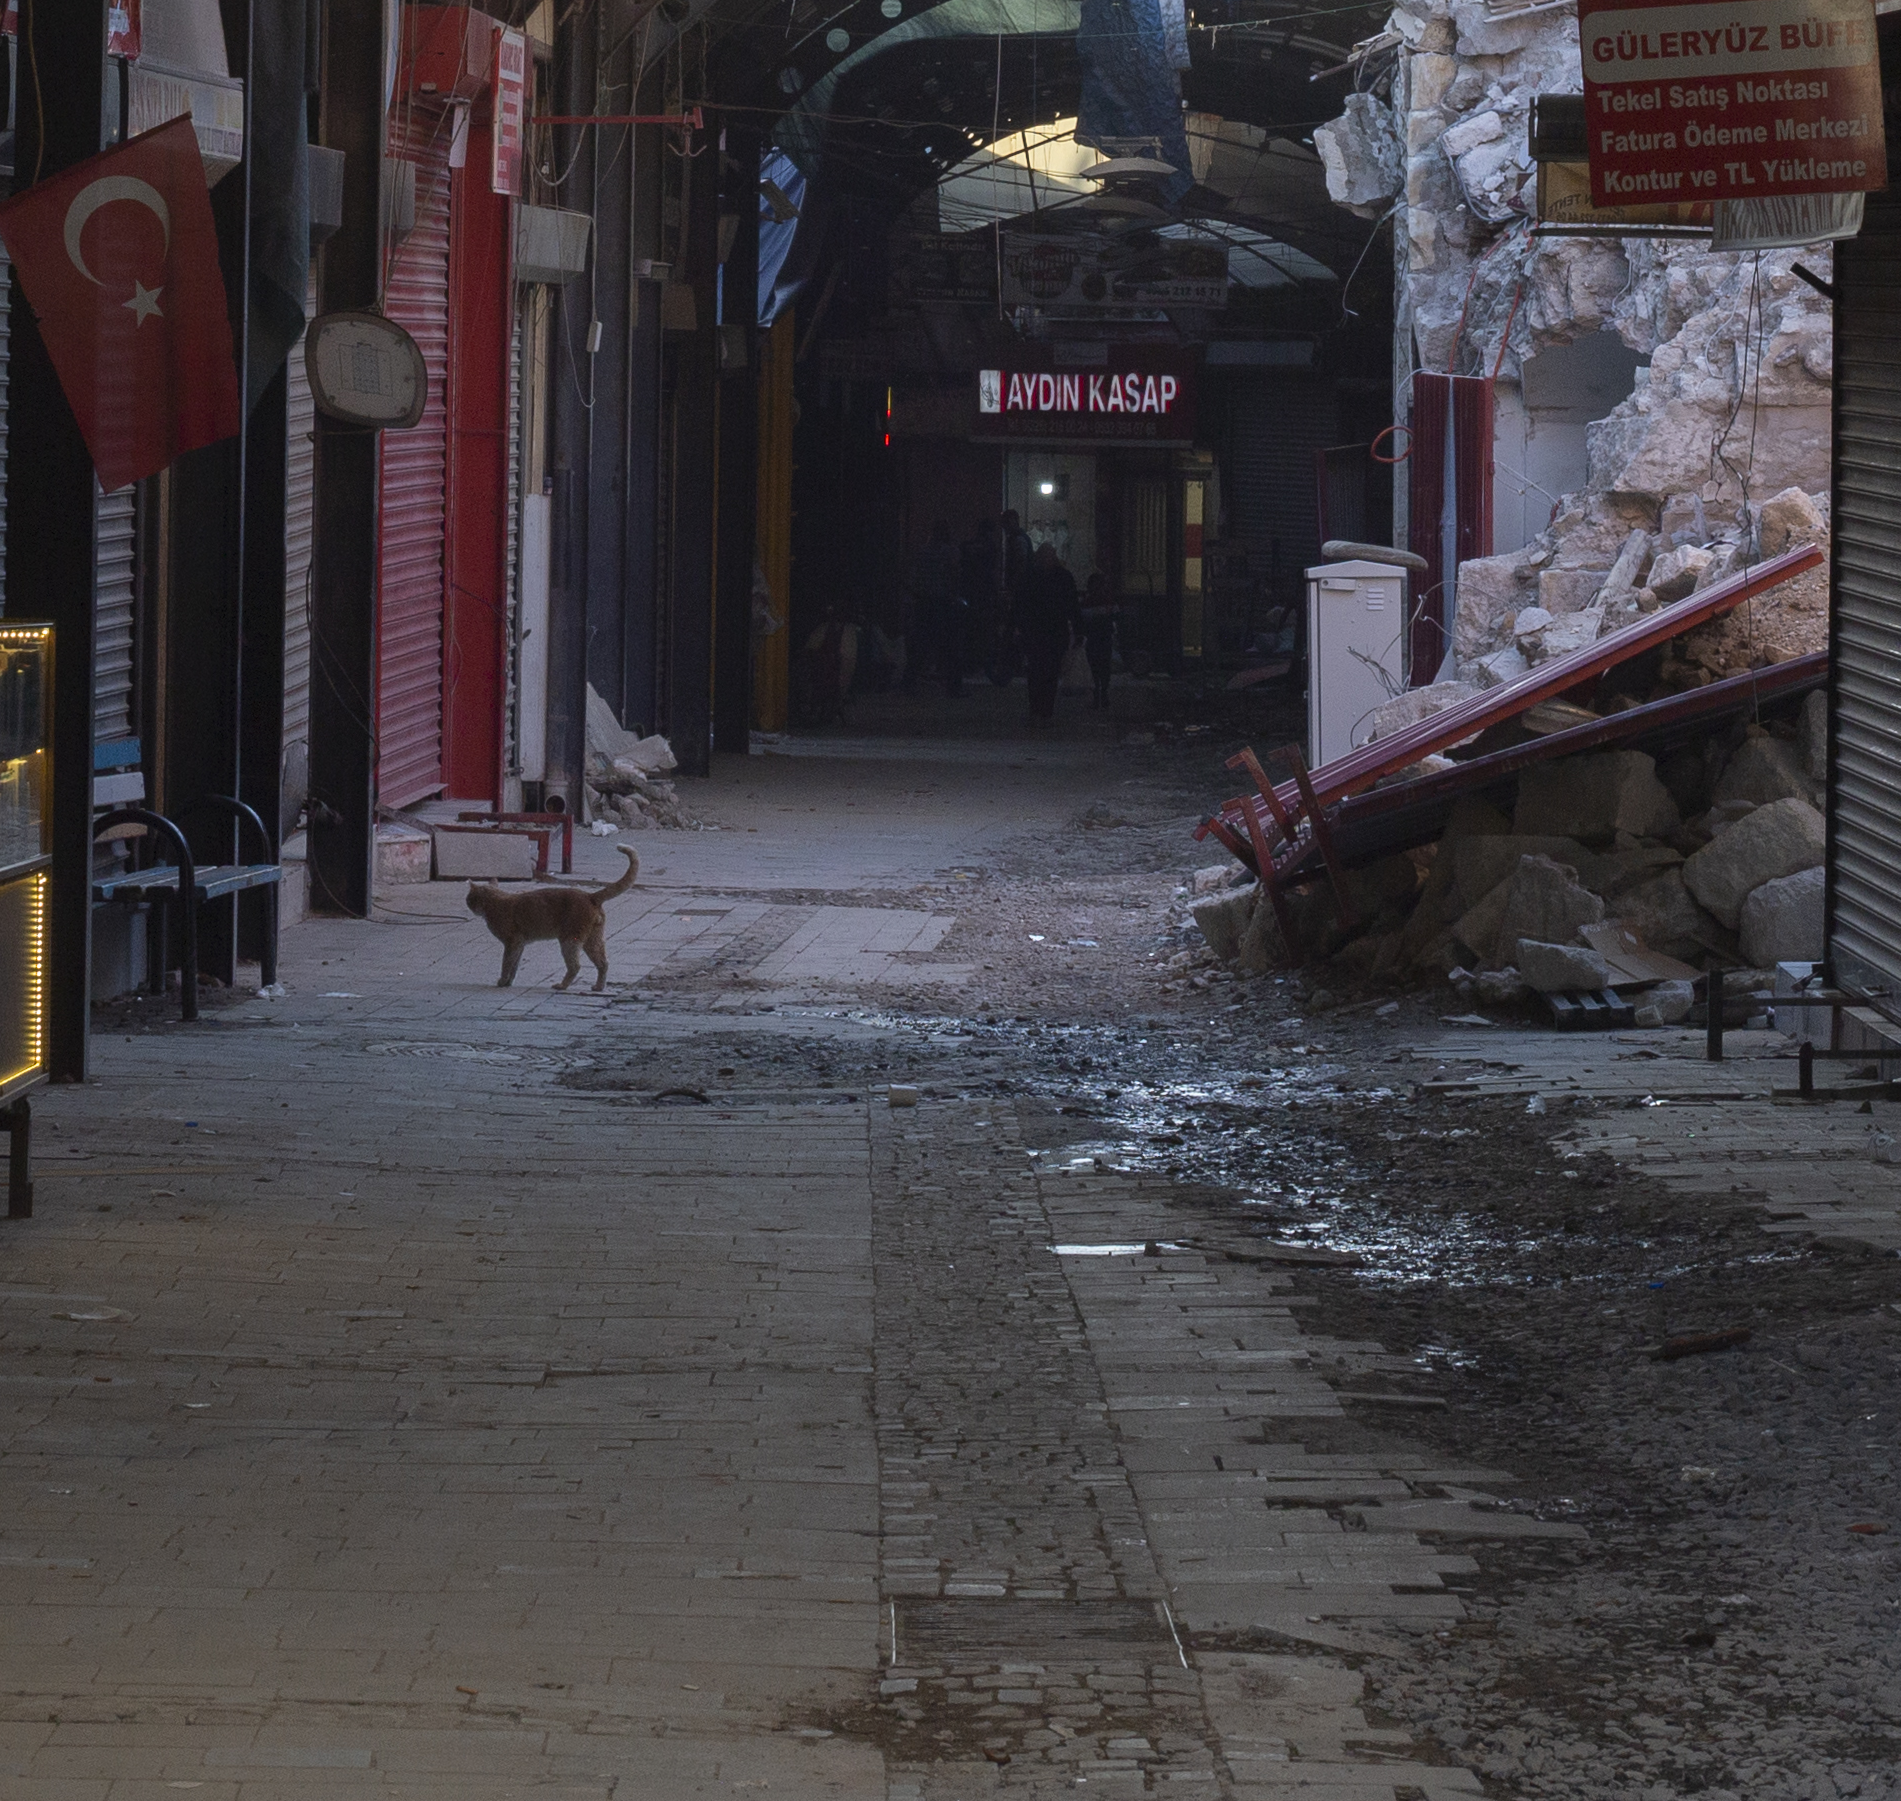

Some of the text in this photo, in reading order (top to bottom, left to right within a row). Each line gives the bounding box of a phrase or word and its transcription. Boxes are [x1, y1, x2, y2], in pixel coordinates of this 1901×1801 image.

[1592, 18, 1867, 63] GÜLERYÜZ BÜFE
[1596, 77, 1828, 114] Tekel Satış Noktası
[1601, 113, 1868, 154] Fatura Ödeme Merkezi
[1603, 156, 1867, 193] Kontur ve TL Yükleme
[1006, 371, 1179, 414] AYDIN KASAP
